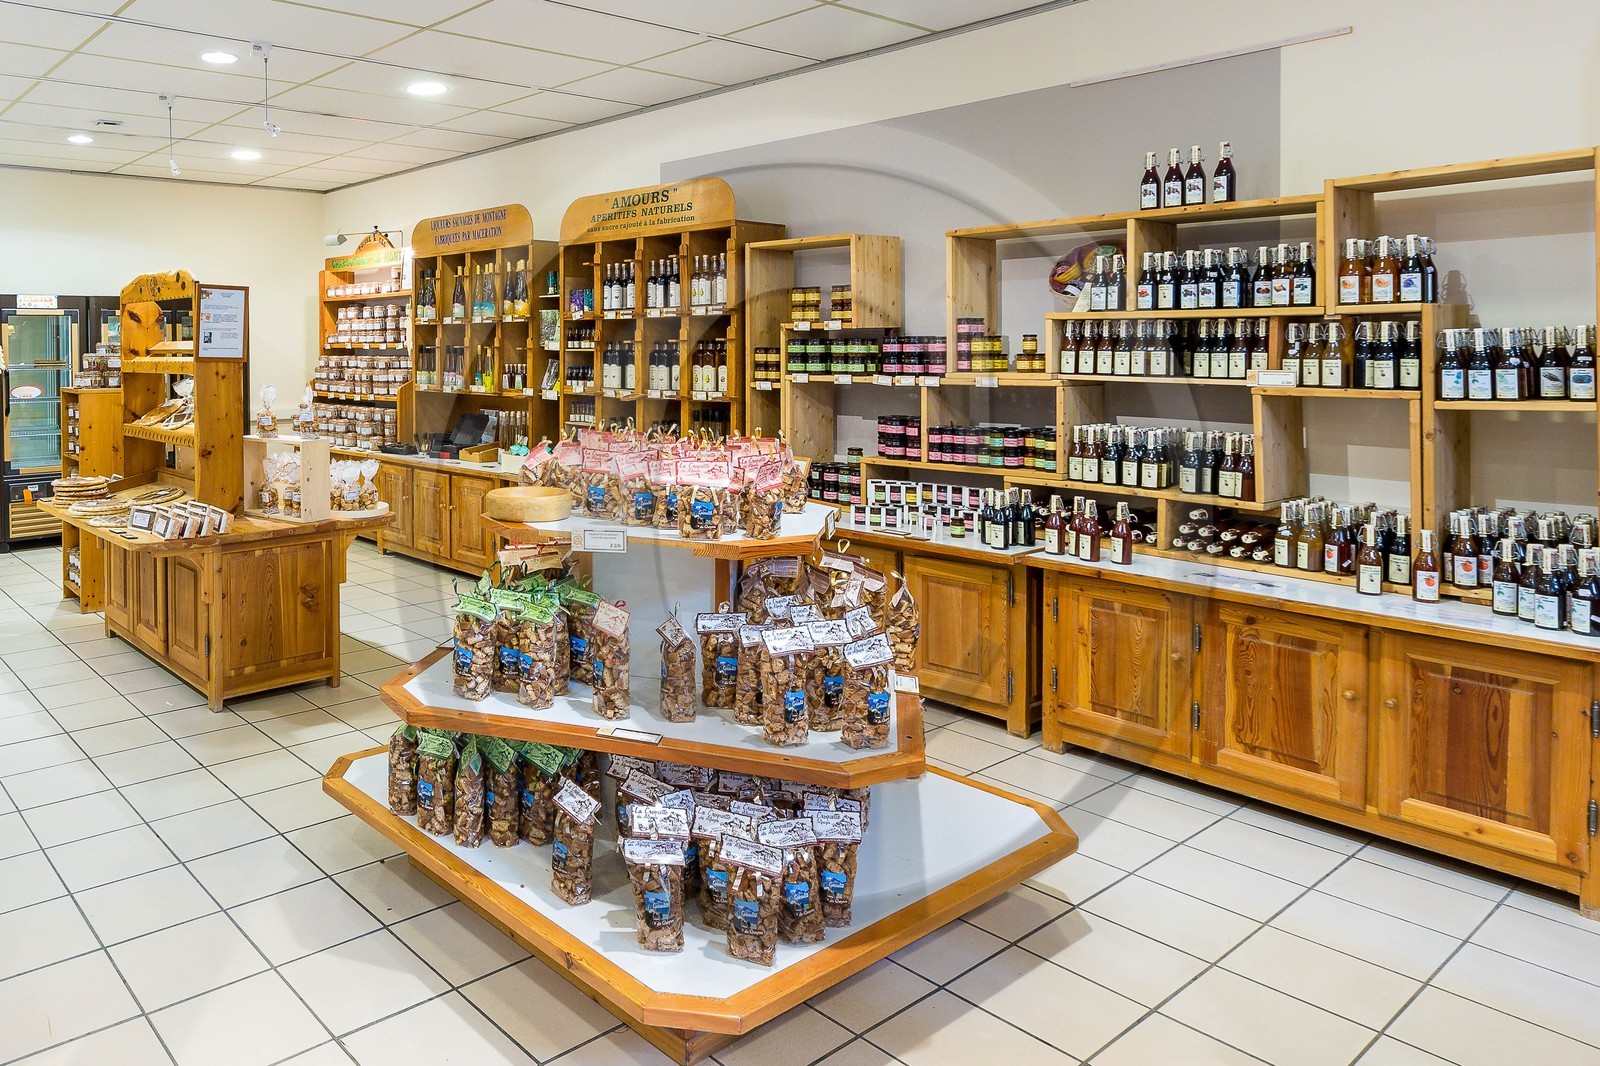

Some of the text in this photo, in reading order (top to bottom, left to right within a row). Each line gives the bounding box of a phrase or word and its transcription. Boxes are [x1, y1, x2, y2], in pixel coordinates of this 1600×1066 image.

[591, 202, 692, 223] APERITIFS NATURELS
[430, 209, 507, 232] LIQUEURS SAUVAGES DE MONTAGNE
[620, 221, 642, 230] rajouté
[657, 215, 695, 225] fabrication
[435, 226, 502, 246] FABRIQUEES PAR MACERATION
[743, 804, 768, 813] Croquette
[708, 809, 731, 820] Croquette
[817, 812, 840, 820] Croquette
[769, 822, 793, 830] Croquette
[736, 839, 762, 850] Croquette
